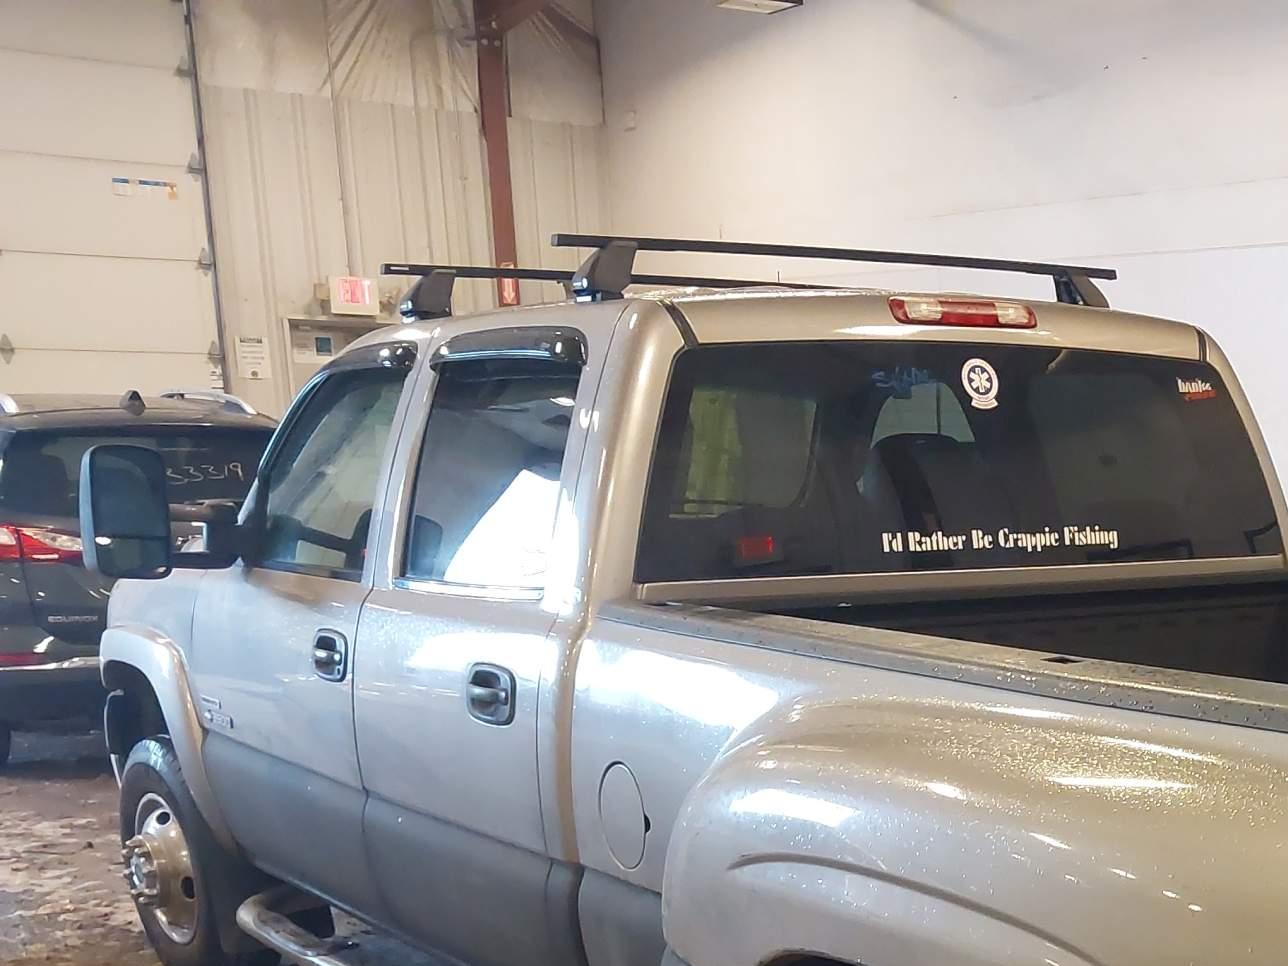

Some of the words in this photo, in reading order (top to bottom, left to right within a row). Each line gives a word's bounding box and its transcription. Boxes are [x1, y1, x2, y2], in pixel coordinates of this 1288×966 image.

[882, 532, 902, 552] I'd
[908, 531, 966, 551] Rather
[972, 529, 993, 549] Be
[998, 527, 1059, 552] Crappie
[1064, 525, 1118, 549] Fishing
